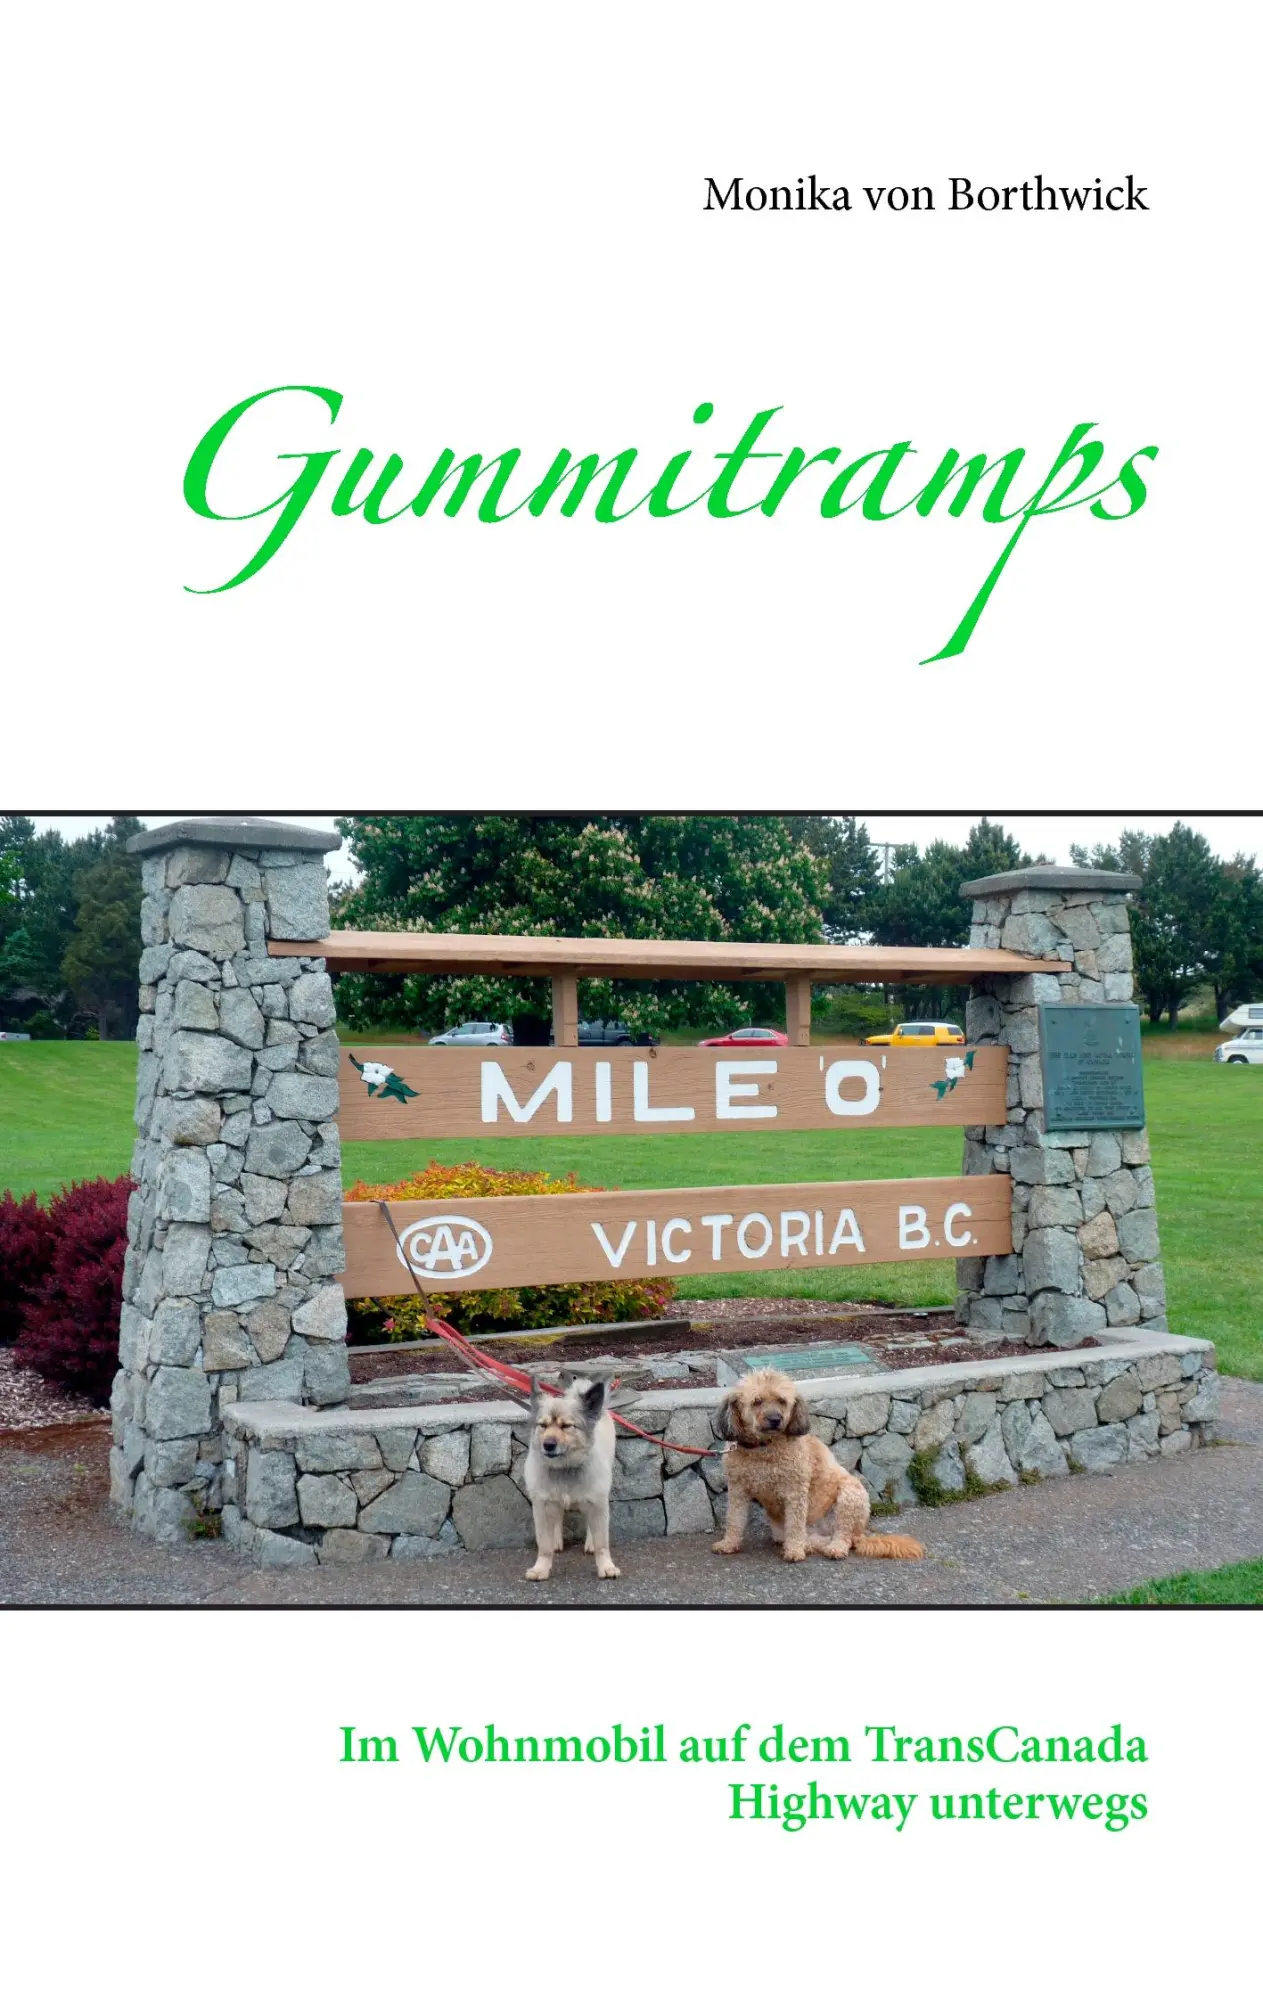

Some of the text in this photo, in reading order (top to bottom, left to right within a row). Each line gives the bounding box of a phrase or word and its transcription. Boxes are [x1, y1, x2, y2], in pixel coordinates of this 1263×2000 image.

[480, 1061, 778, 1122] MILE
[409, 1224, 479, 1270] CAA
[591, 1202, 978, 1268] VICTORIA B.C.
